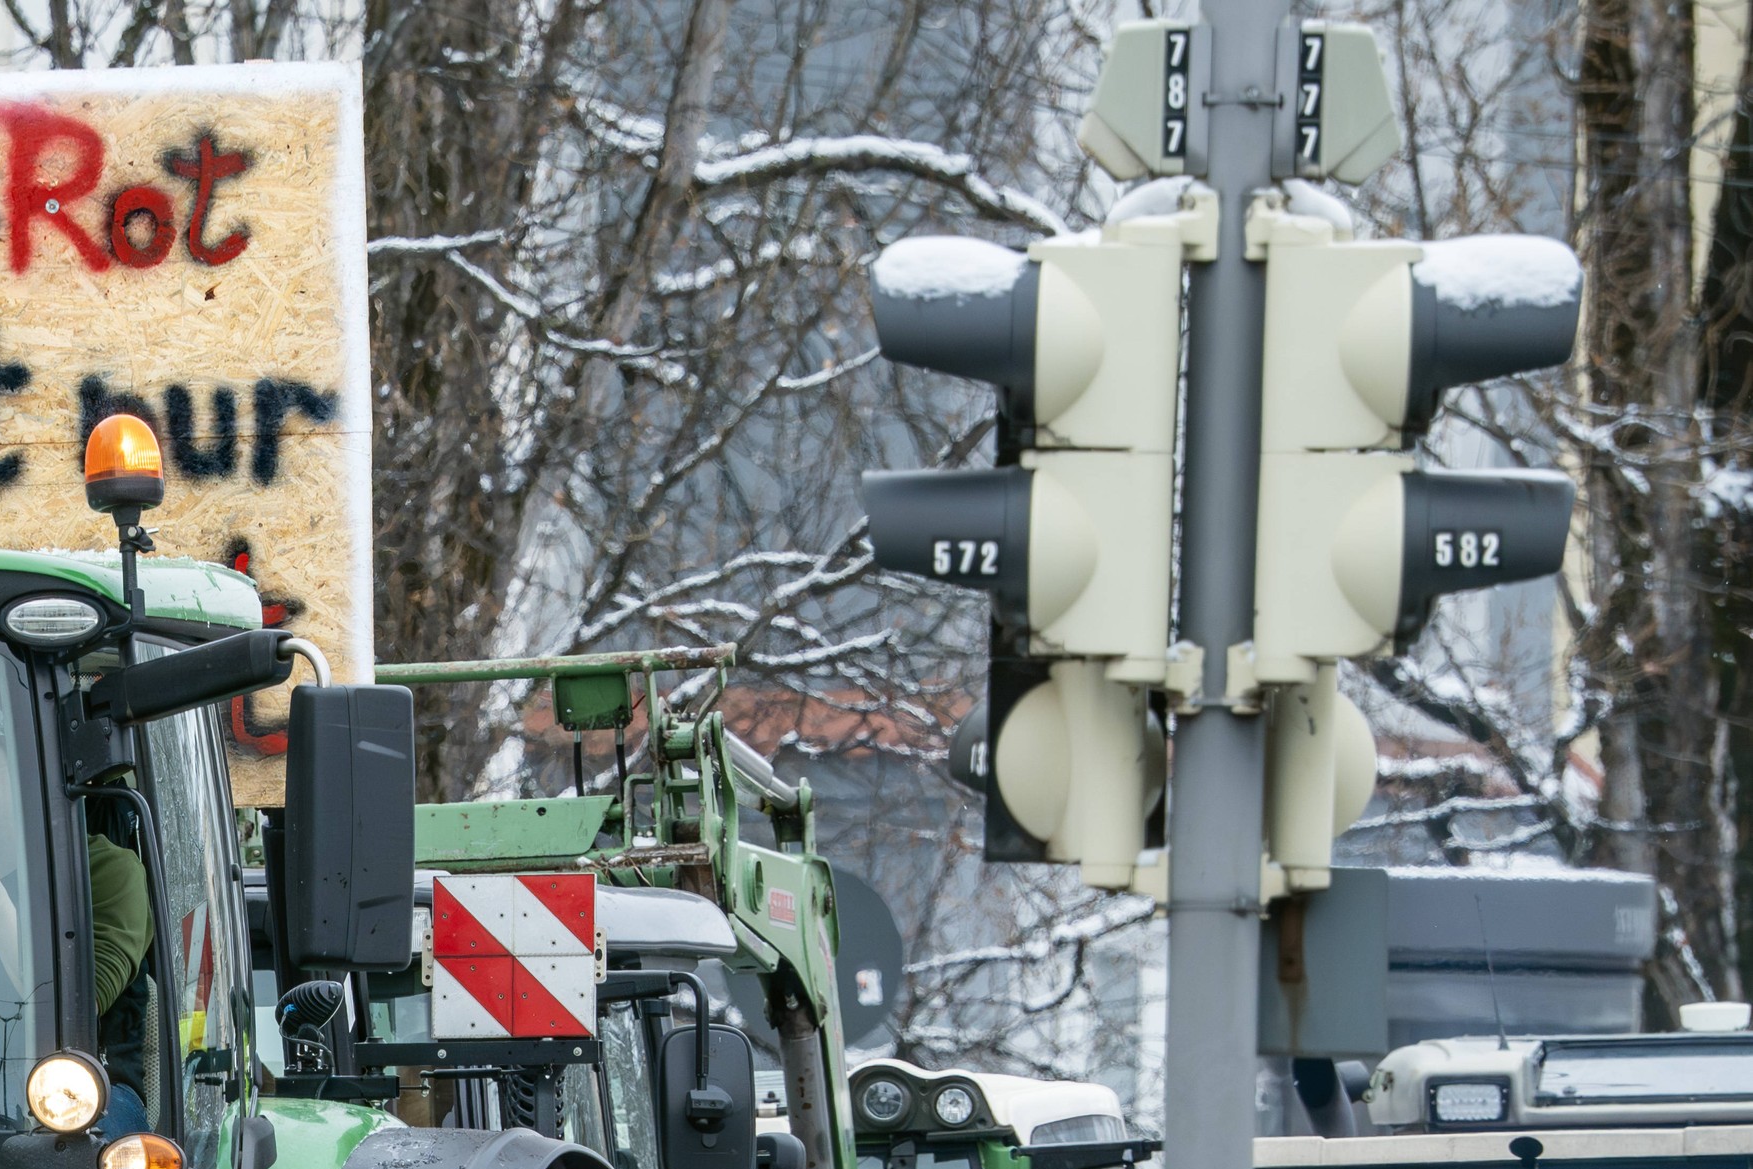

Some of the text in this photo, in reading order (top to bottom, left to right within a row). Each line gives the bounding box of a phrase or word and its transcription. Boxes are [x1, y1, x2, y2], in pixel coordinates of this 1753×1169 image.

[1166, 33, 1187, 154] 787
[1300, 35, 1323, 159] 777
[932, 540, 999, 576] 572
[1434, 532, 1501, 568] 582
